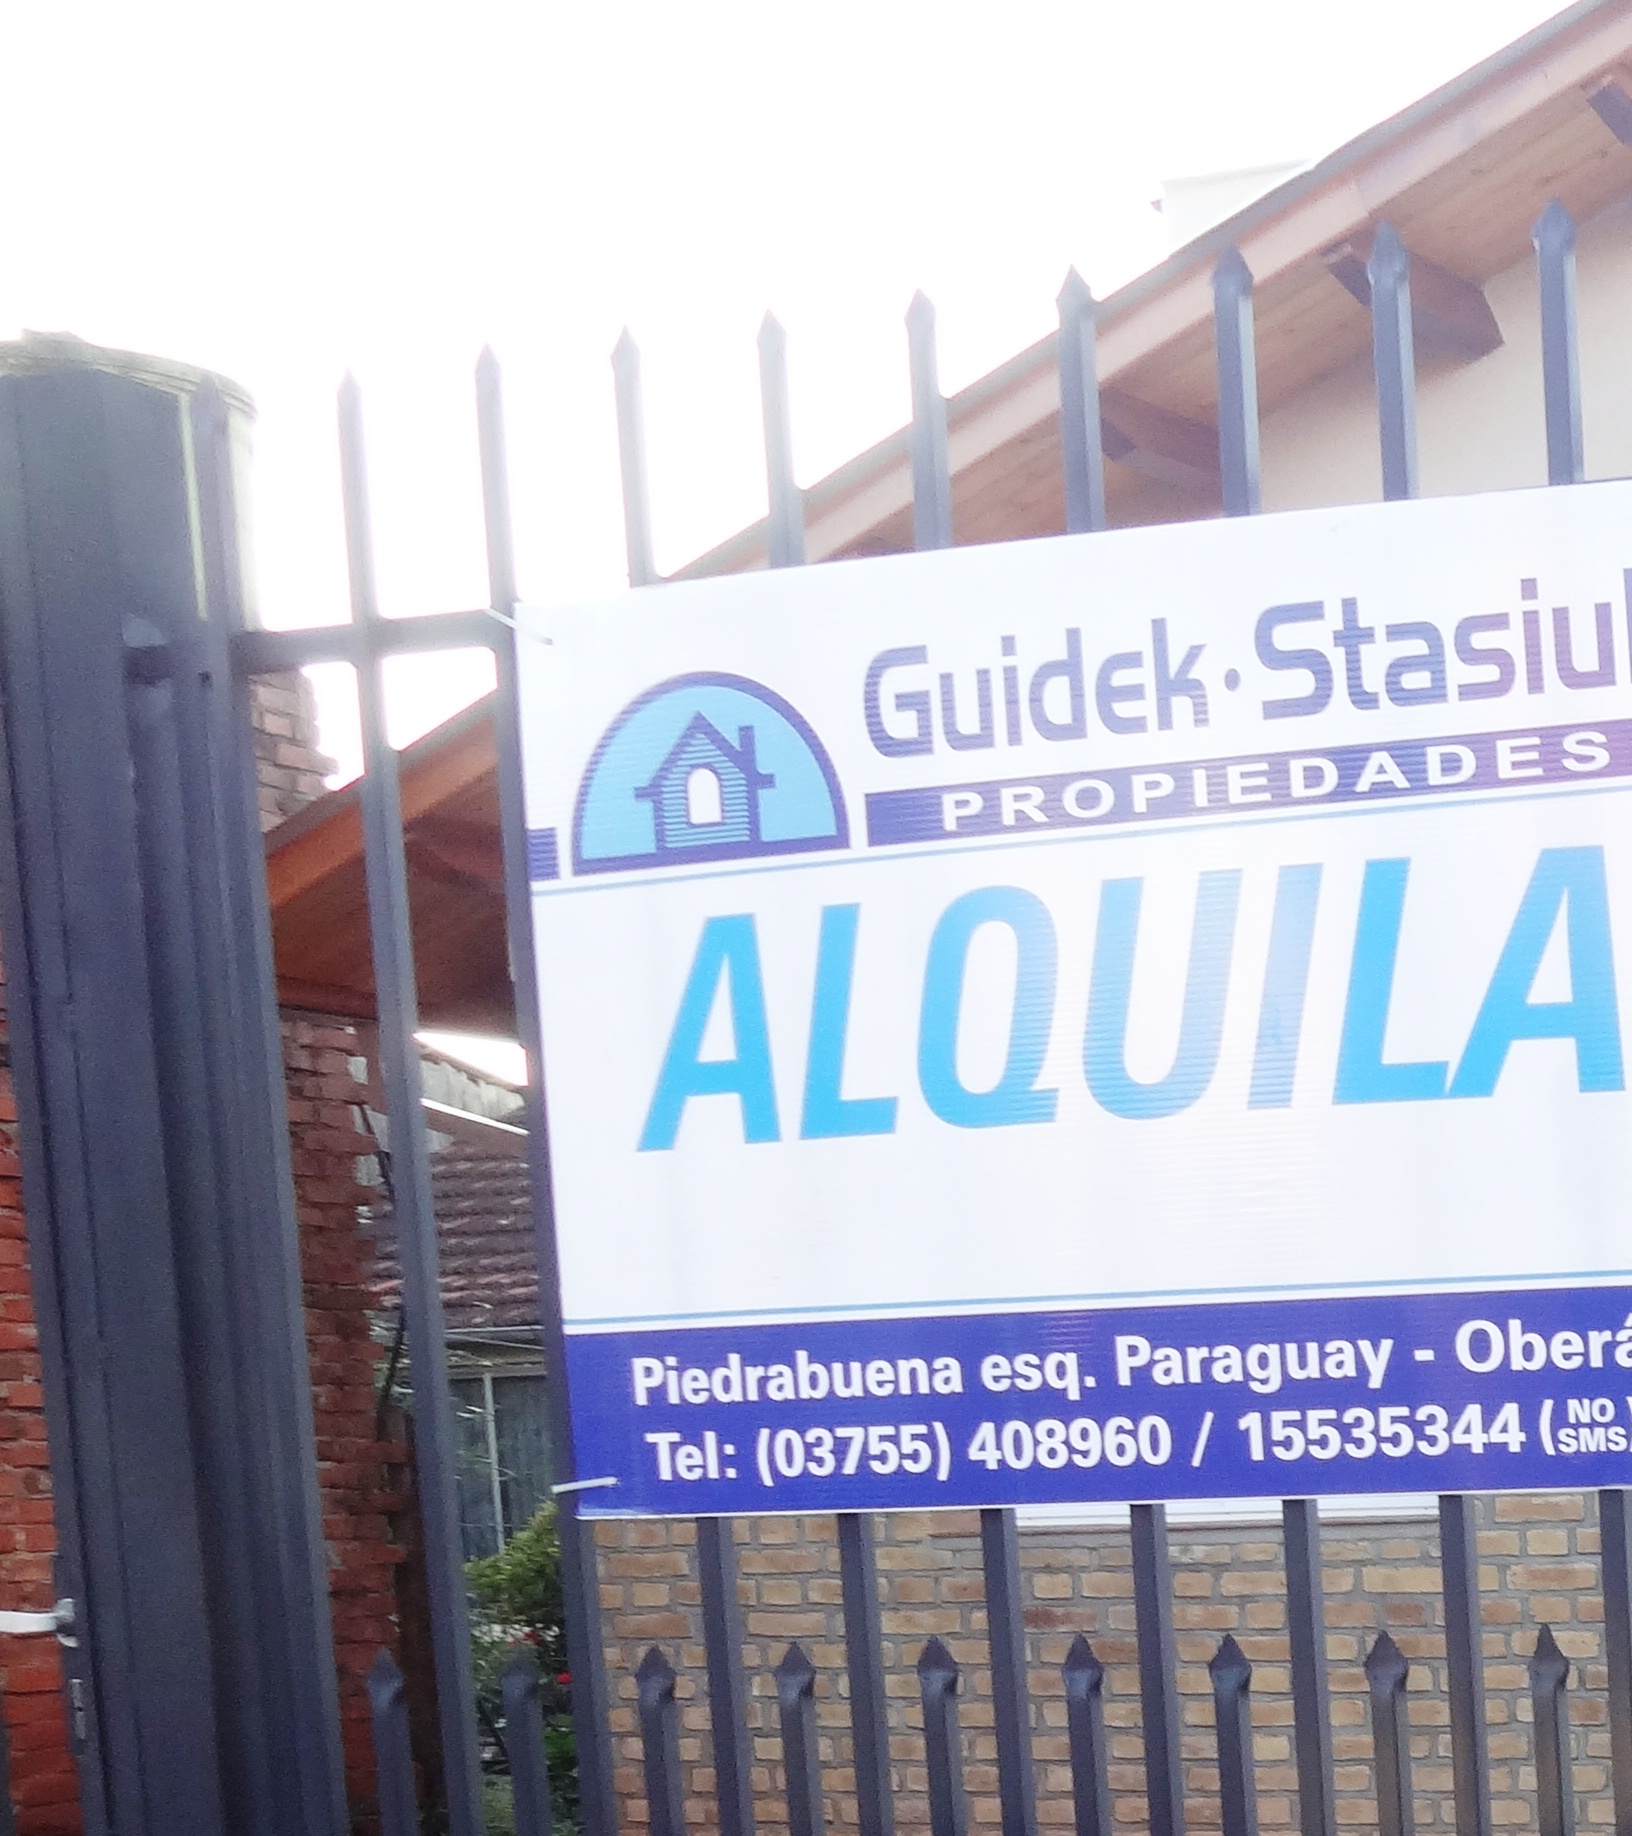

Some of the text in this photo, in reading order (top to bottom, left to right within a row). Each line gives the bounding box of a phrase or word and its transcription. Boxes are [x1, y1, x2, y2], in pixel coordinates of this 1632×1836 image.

[942, 730, 1610, 831] PROPIEDADES
[636, 845, 1627, 1153] ALQUILA
[631, 1349, 963, 1406] Piedrabuena
[981, 1351, 1096, 1401] esq.
[1115, 1335, 1393, 1394] Paraguay
[645, 1430, 737, 1481] Tel:
[757, 1421, 951, 1487] (03755)
[968, 1414, 1172, 1471] 408960
[1191, 1411, 1214, 1468] /
[1238, 1402, 1526, 1462] 15535344
